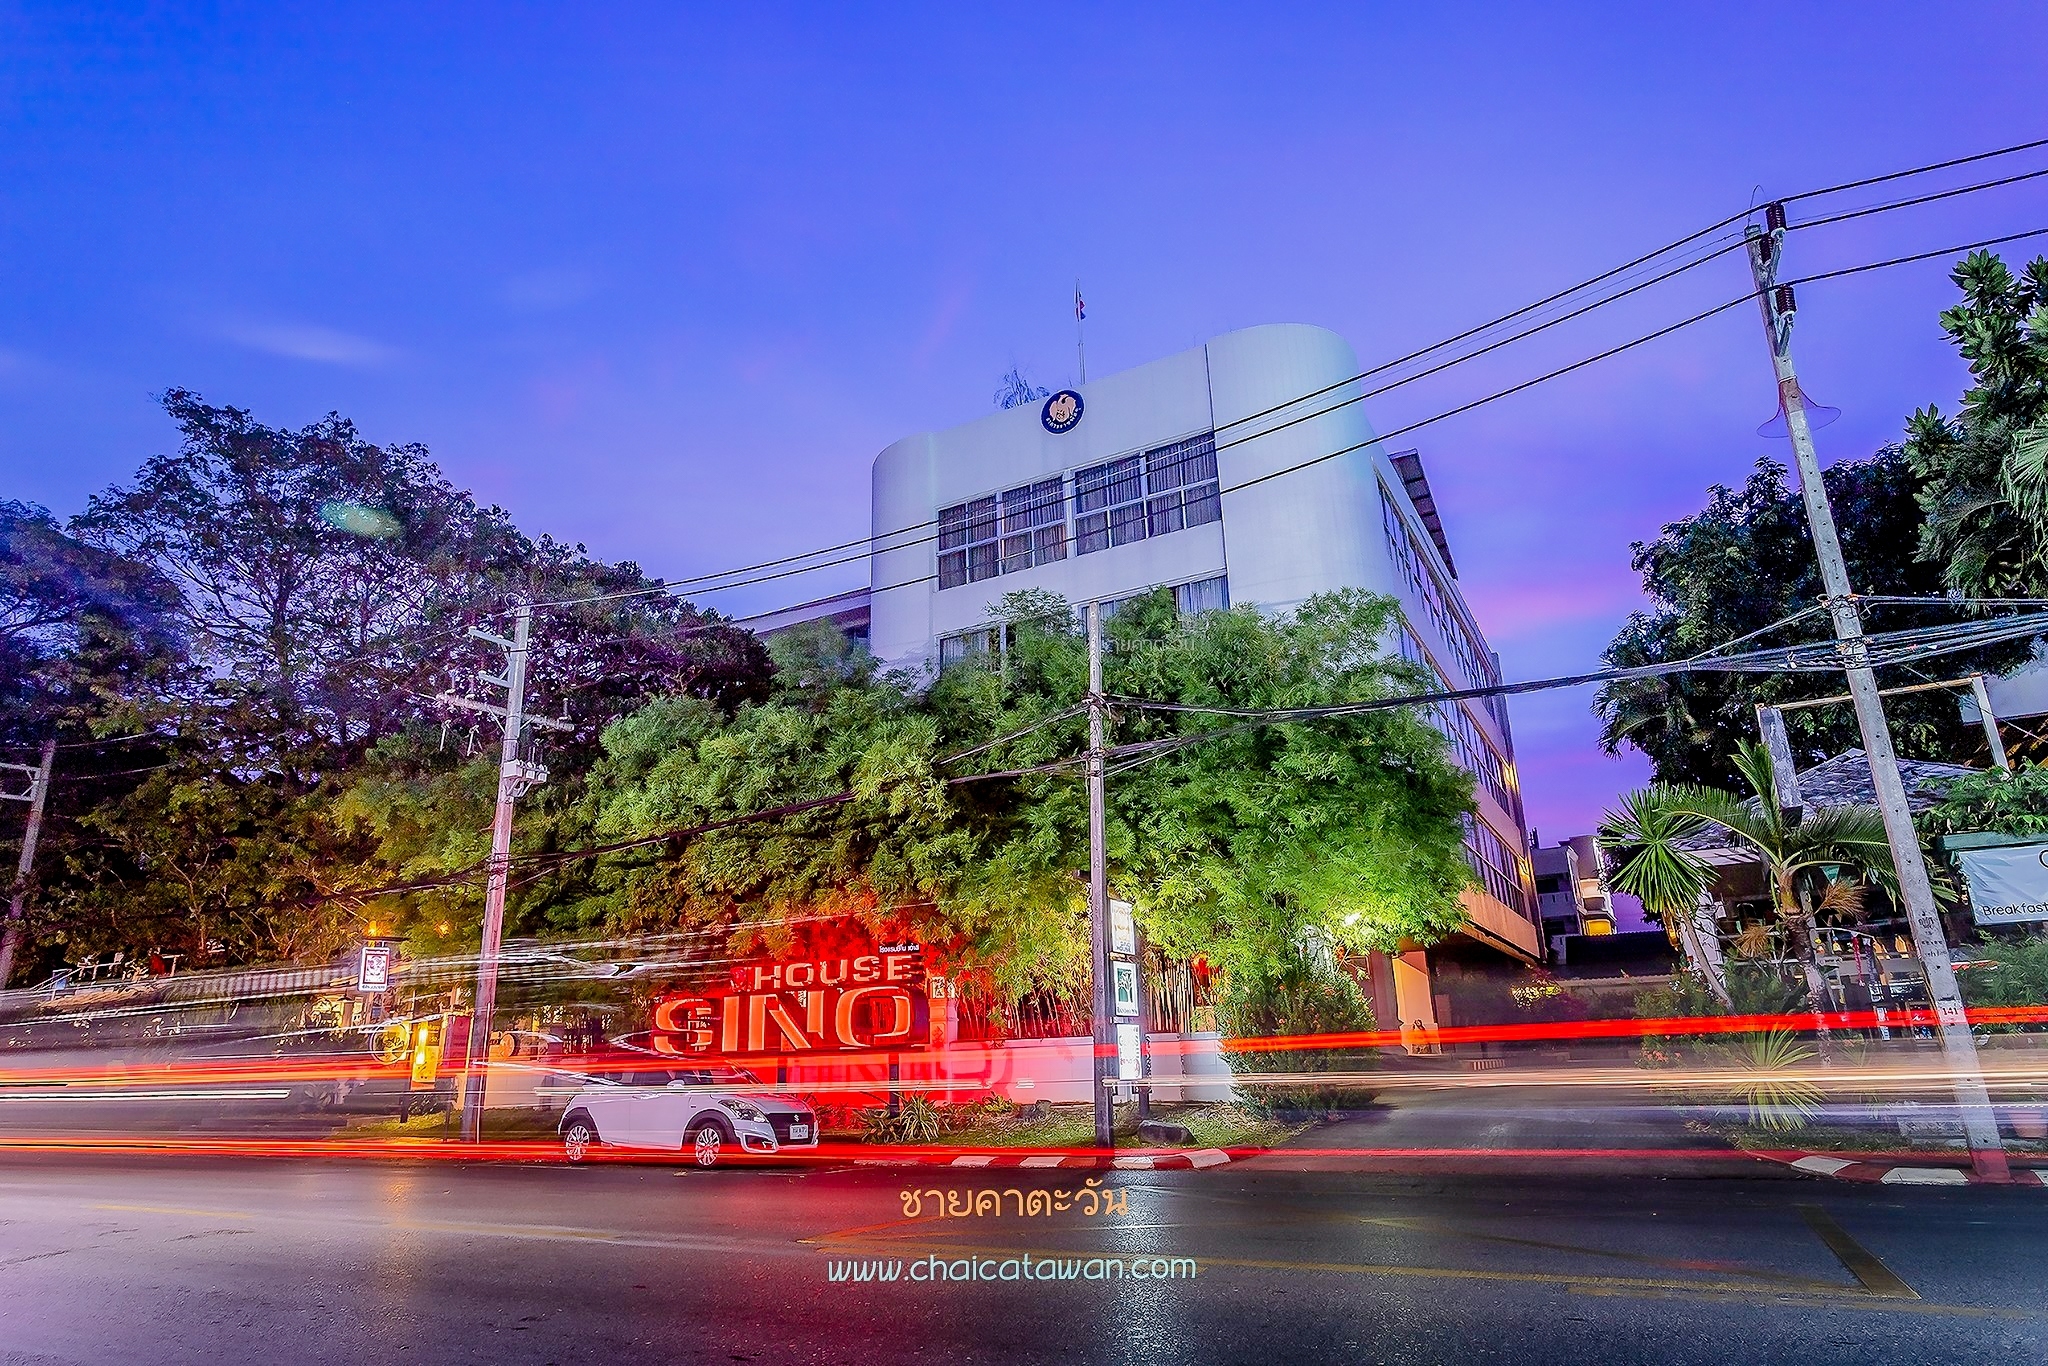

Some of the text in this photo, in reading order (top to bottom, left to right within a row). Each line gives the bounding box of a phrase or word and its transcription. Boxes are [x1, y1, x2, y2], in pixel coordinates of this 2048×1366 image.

[1982, 901, 2048, 917] Breakfast
[753, 954, 914, 990] HOUSE
[653, 985, 914, 1056] SINO
[1942, 1007, 1959, 1016] 141
